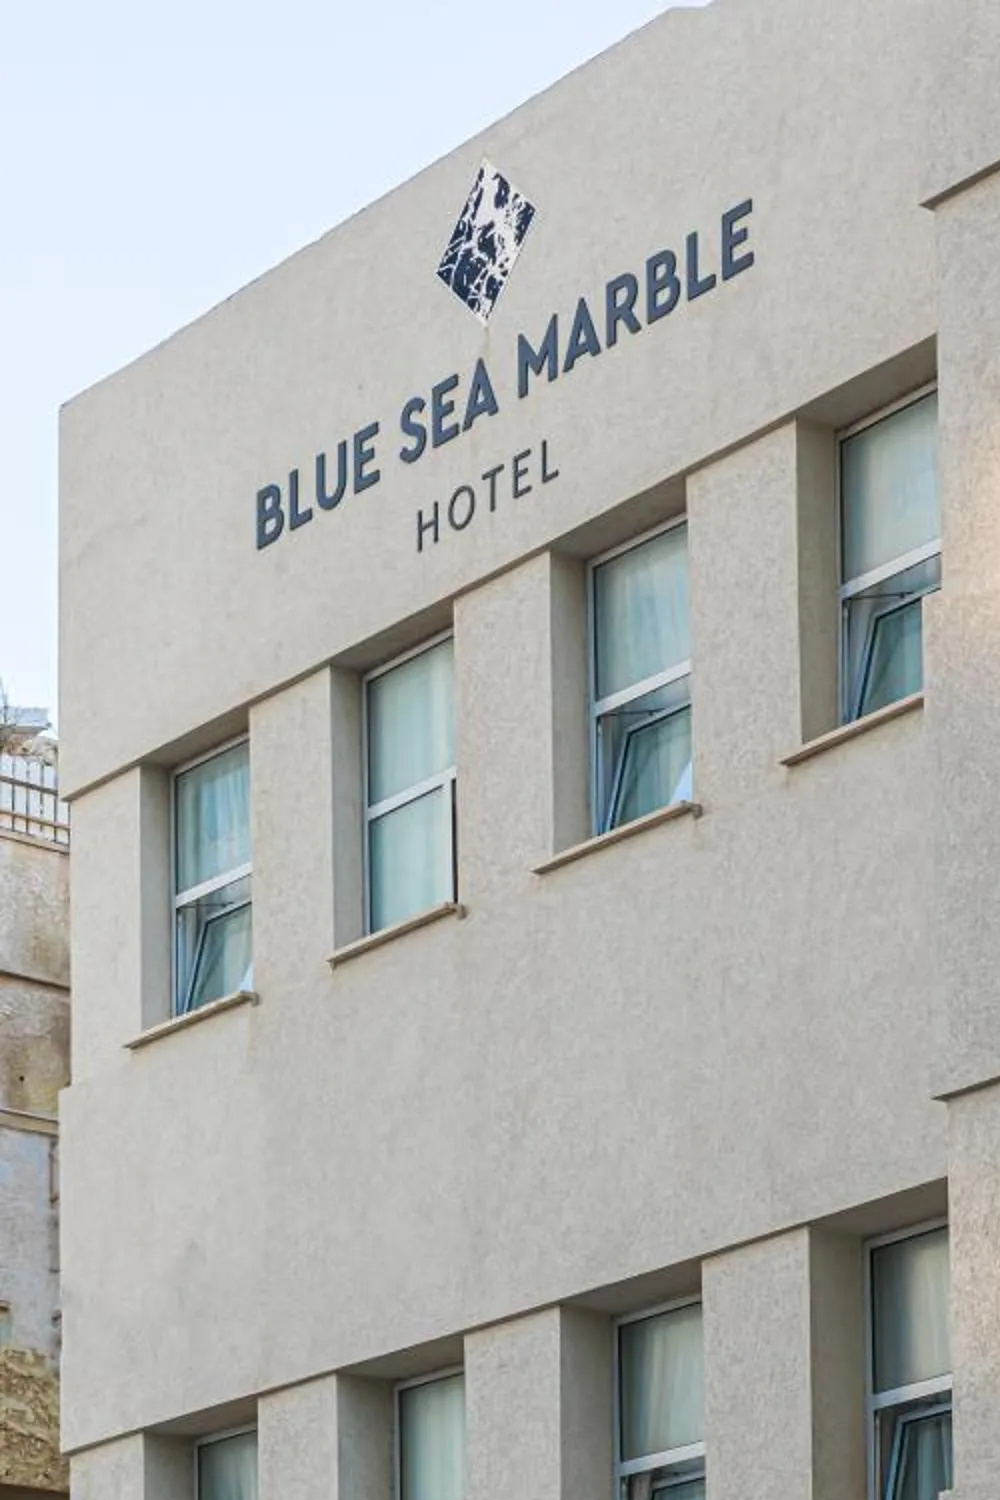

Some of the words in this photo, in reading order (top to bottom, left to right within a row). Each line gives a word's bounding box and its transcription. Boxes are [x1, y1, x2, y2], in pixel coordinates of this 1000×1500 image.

[256, 421, 381, 551] BLUE
[400, 357, 499, 465] SEA
[516, 198, 756, 399] MARBLE
[416, 439, 560, 553] HOTEL
